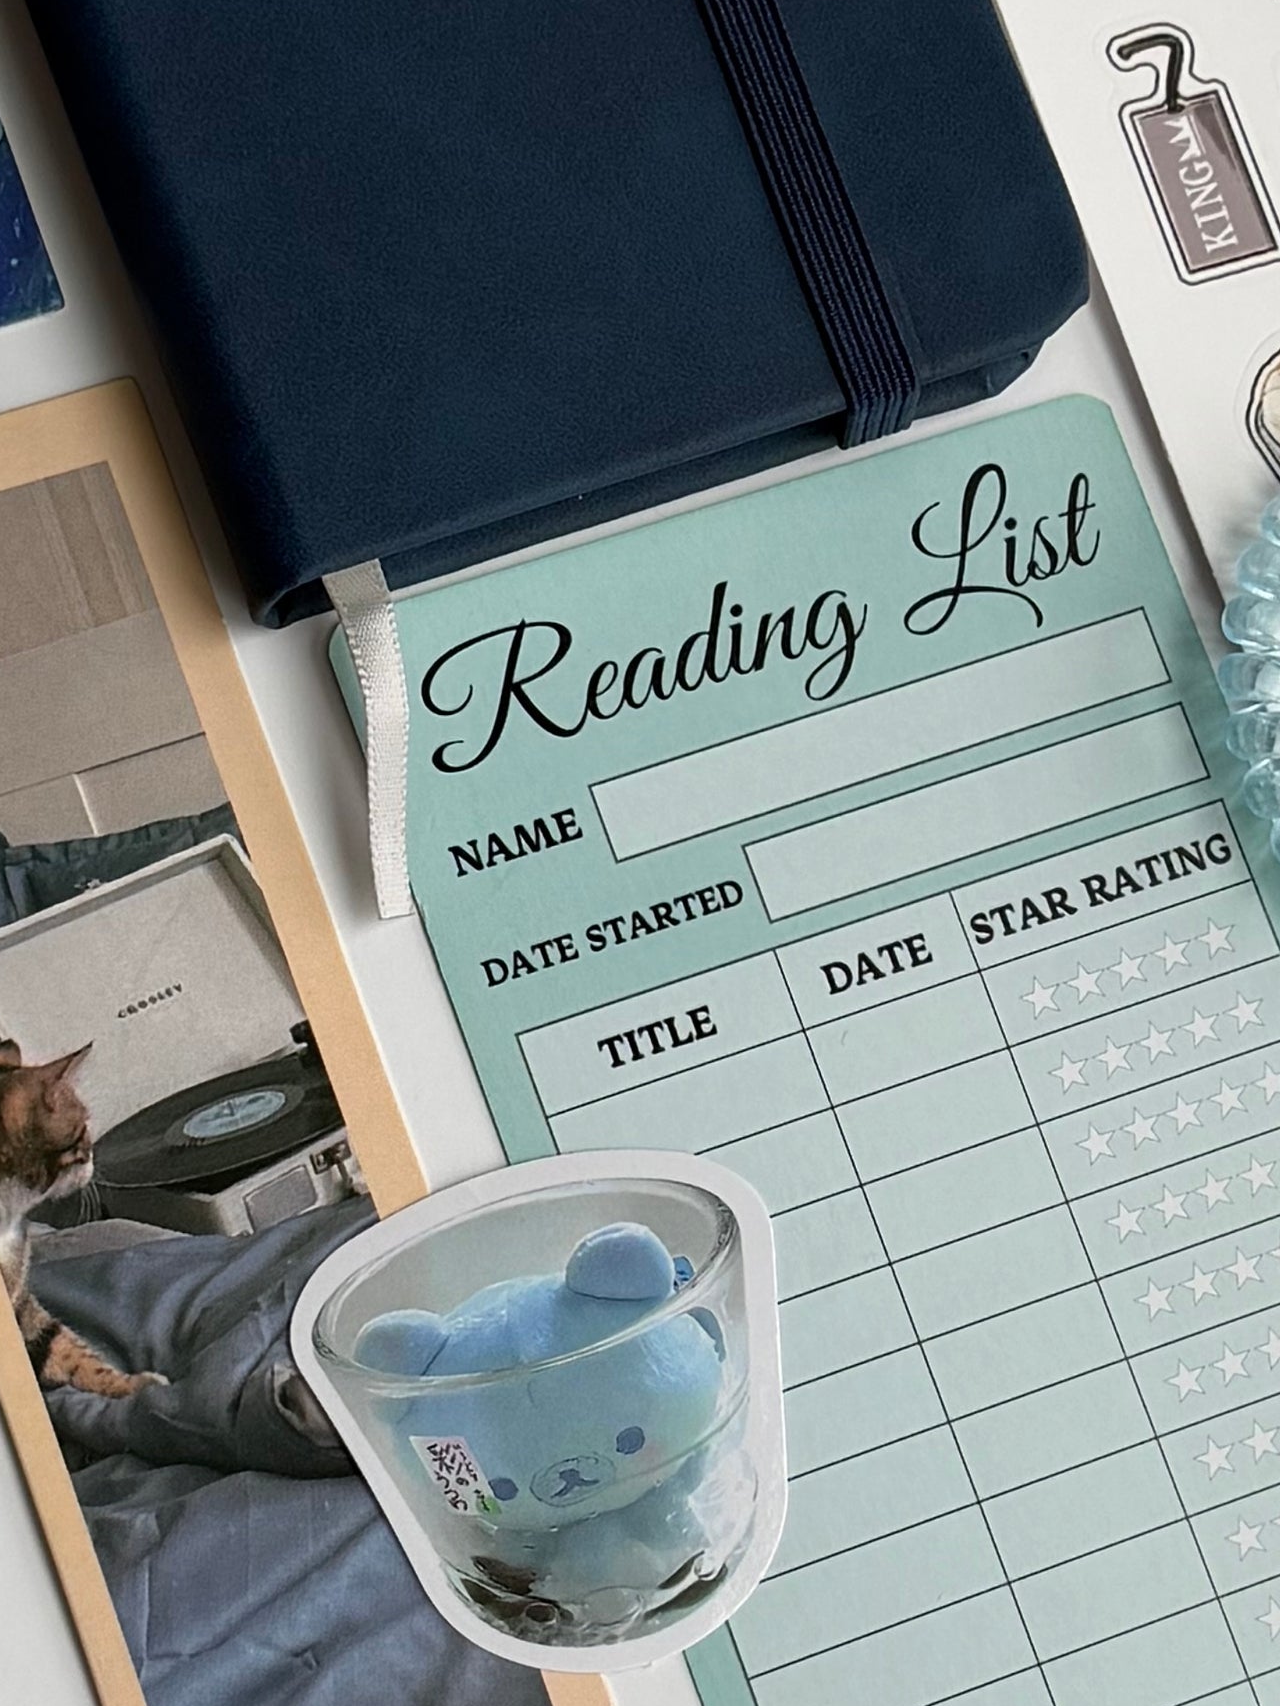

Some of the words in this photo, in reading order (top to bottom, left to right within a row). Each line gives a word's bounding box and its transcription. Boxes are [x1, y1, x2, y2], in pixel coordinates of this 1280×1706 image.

[421, 581, 868, 773] Reading
[903, 463, 1100, 634] List
[448, 808, 584, 879] NAME
[481, 933, 580, 989] DATE
[584, 879, 744, 954] STARTED
[969, 886, 1075, 946] STAR
[1082, 832, 1233, 907] RATING
[820, 933, 934, 996] DATE
[596, 1005, 719, 1070] TITLE
